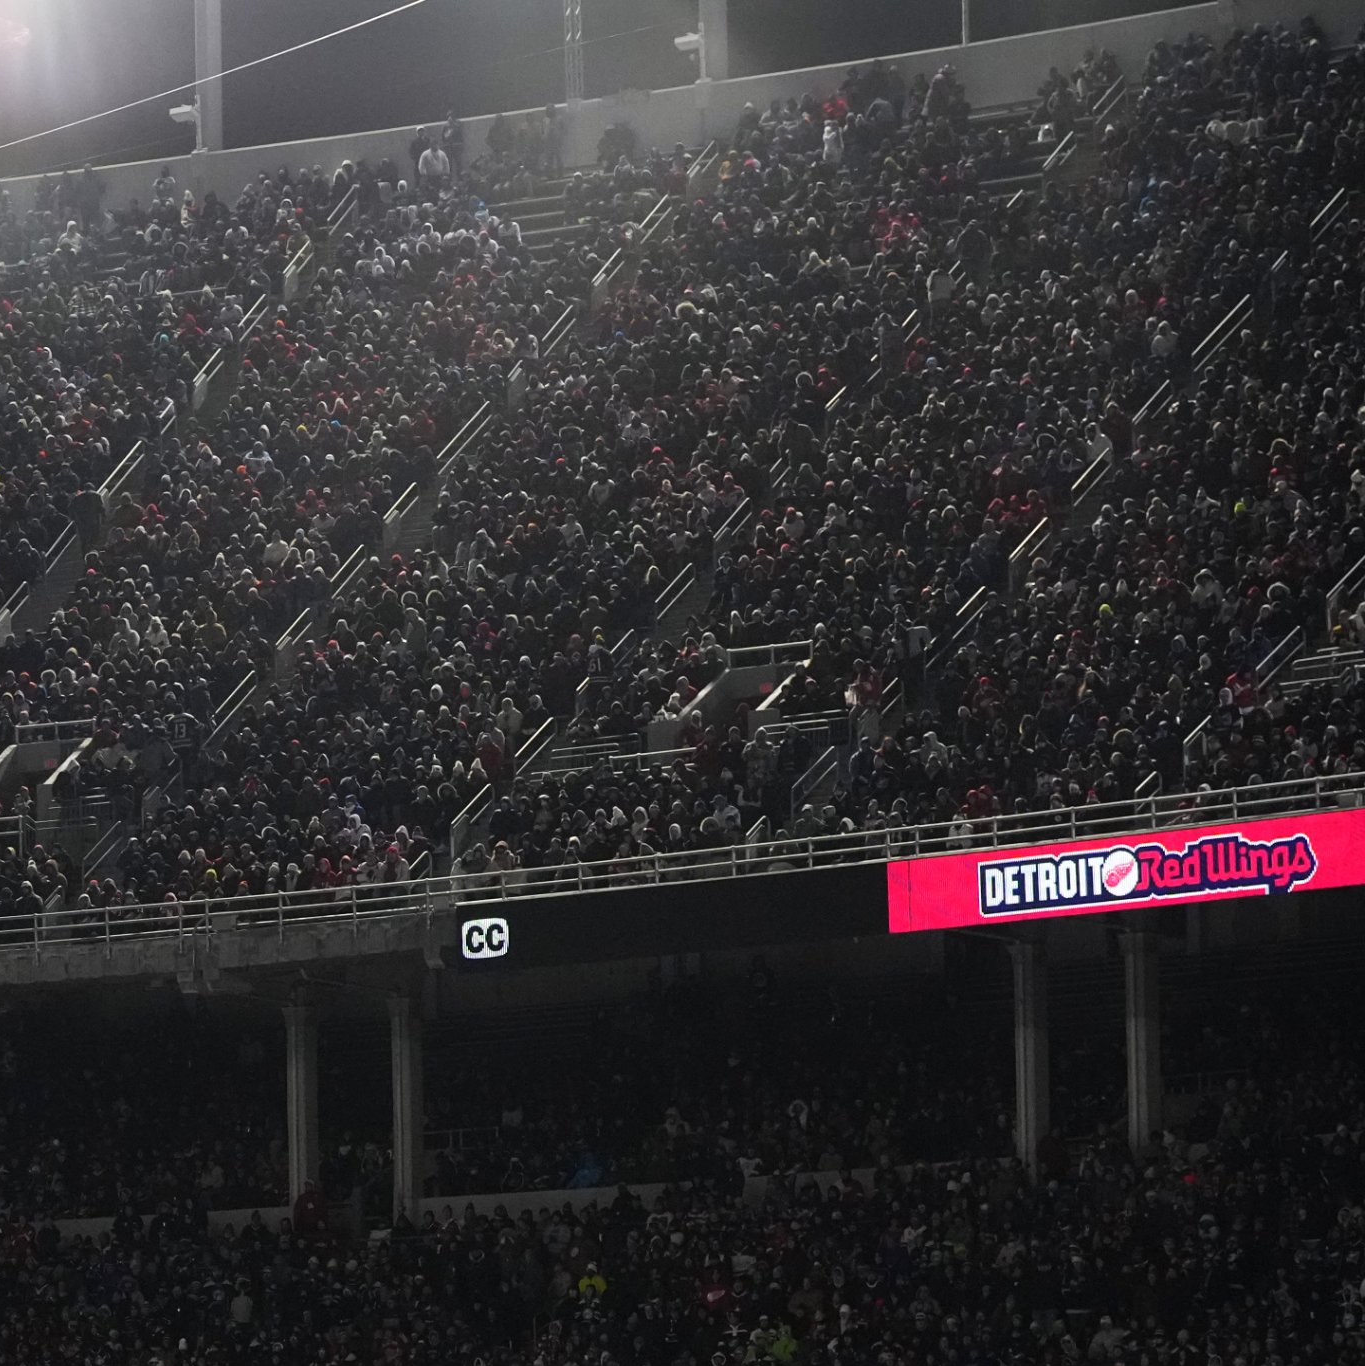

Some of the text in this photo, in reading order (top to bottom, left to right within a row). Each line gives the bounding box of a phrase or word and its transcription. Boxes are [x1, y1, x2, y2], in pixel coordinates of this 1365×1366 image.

[986, 842, 1312, 907] DETROIT Red Wings
[465, 923, 507, 954] CC
